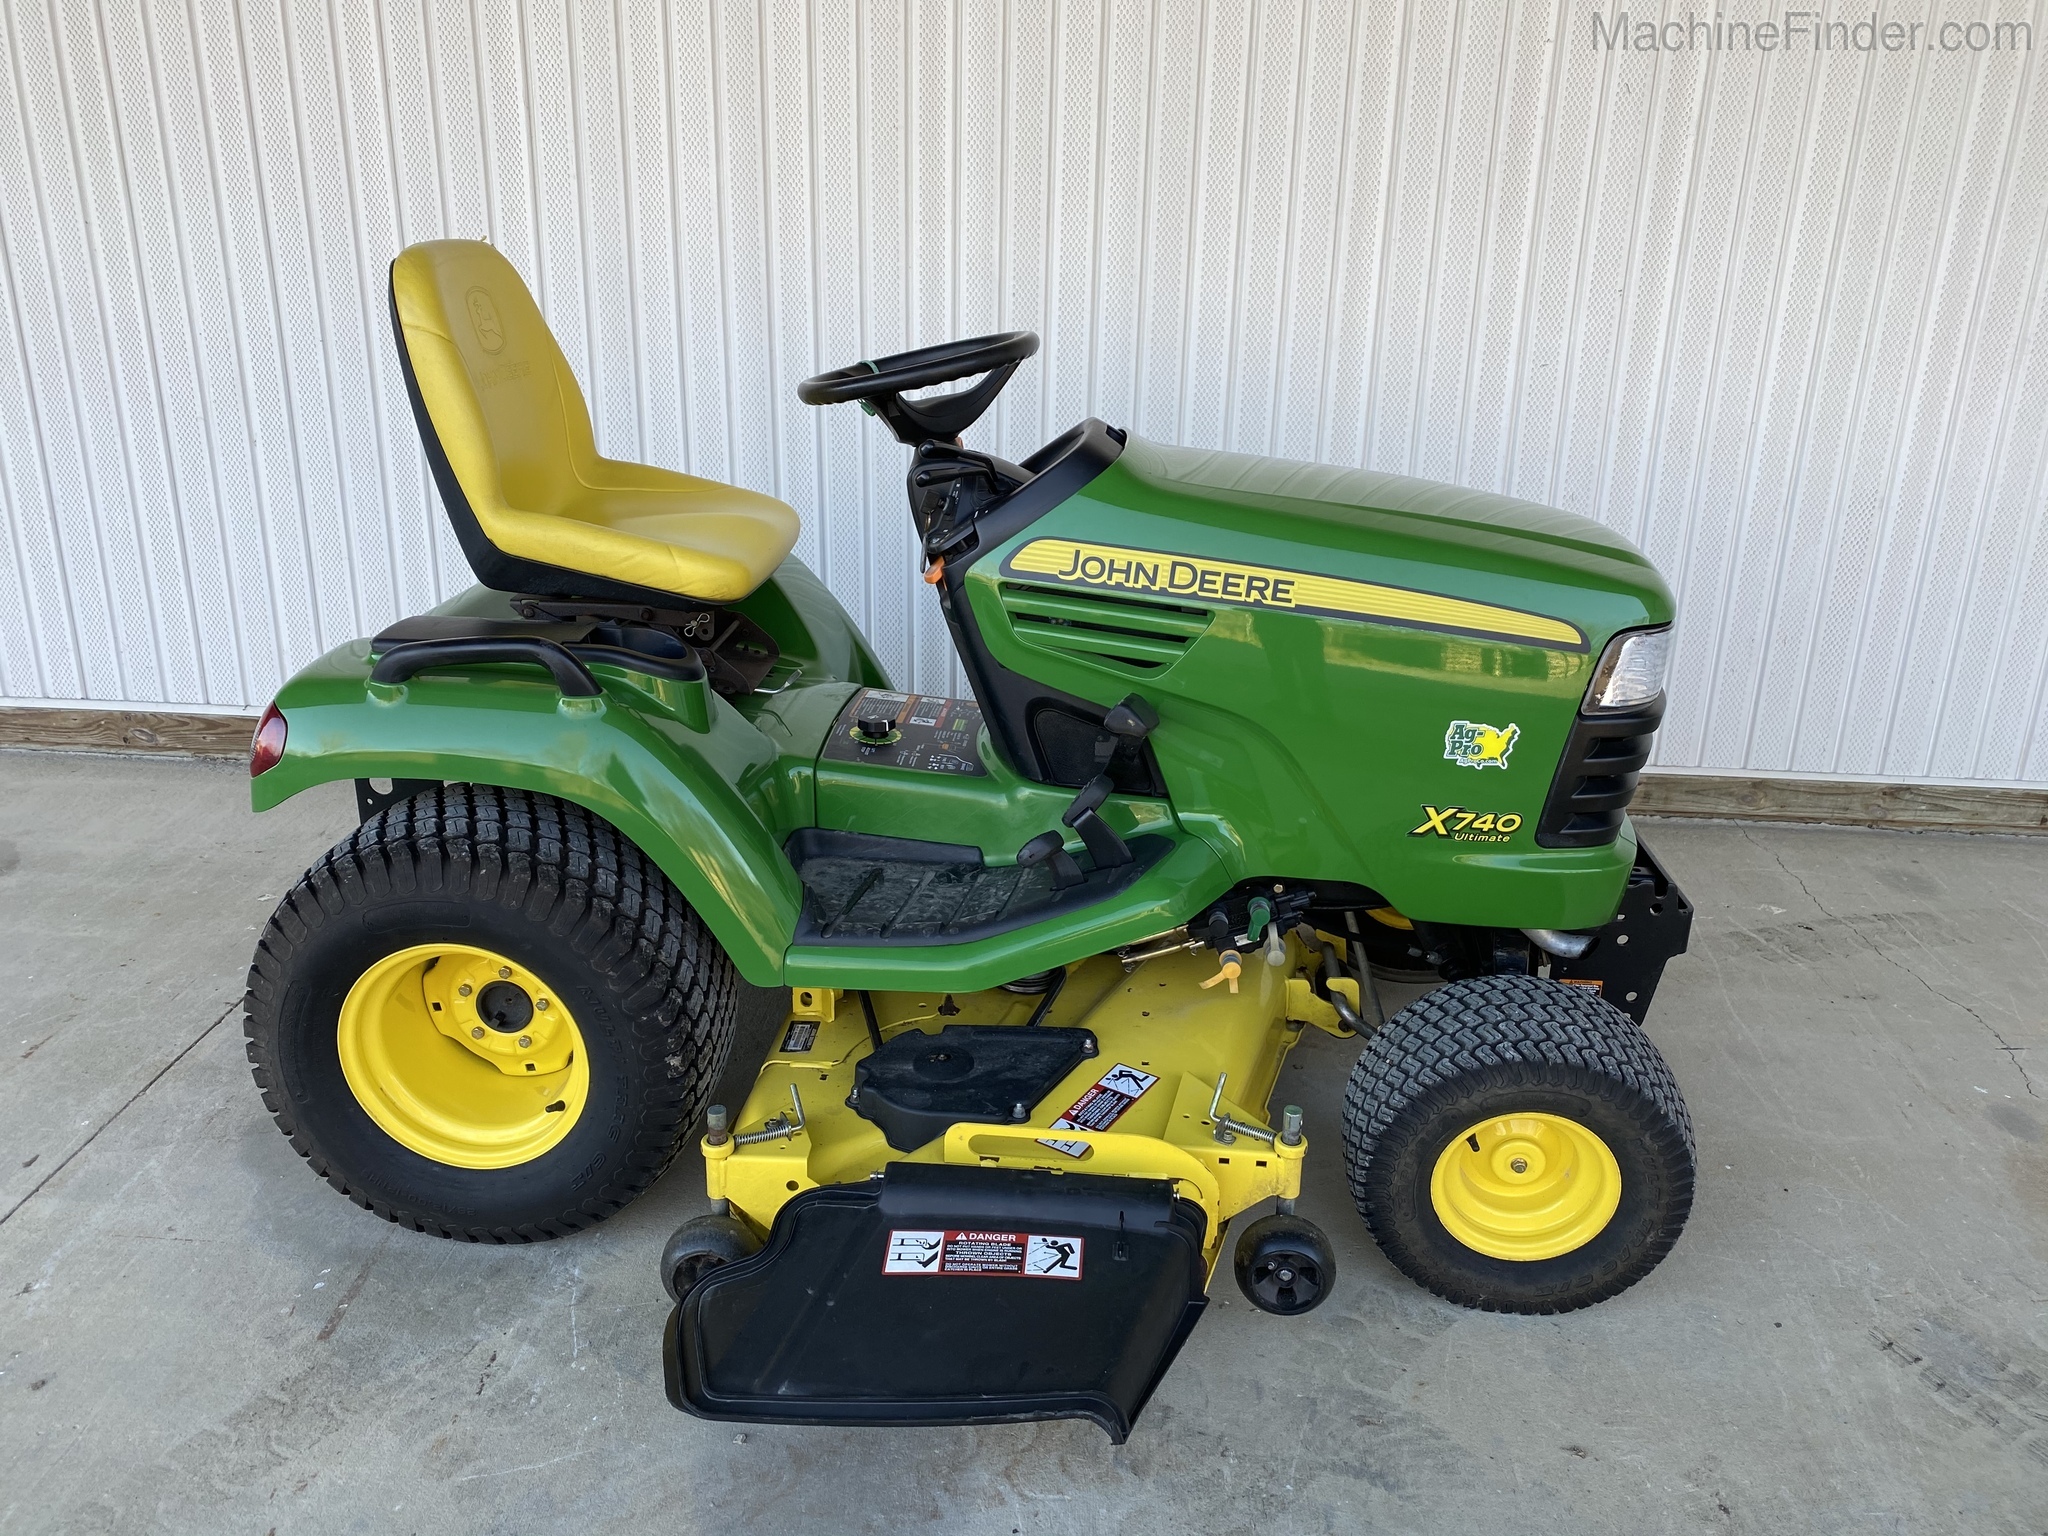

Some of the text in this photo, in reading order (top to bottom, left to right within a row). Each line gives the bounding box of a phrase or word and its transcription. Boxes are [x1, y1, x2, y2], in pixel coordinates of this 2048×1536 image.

[1059, 548, 1295, 604] JOHN DEERE
[1448, 740, 1483, 756] Pro
[1411, 805, 1523, 836] X740
[1453, 832, 1511, 843] Ultimate
[1075, 1088, 1099, 1110] DANGER
[969, 1233, 1016, 1241] DANGER
